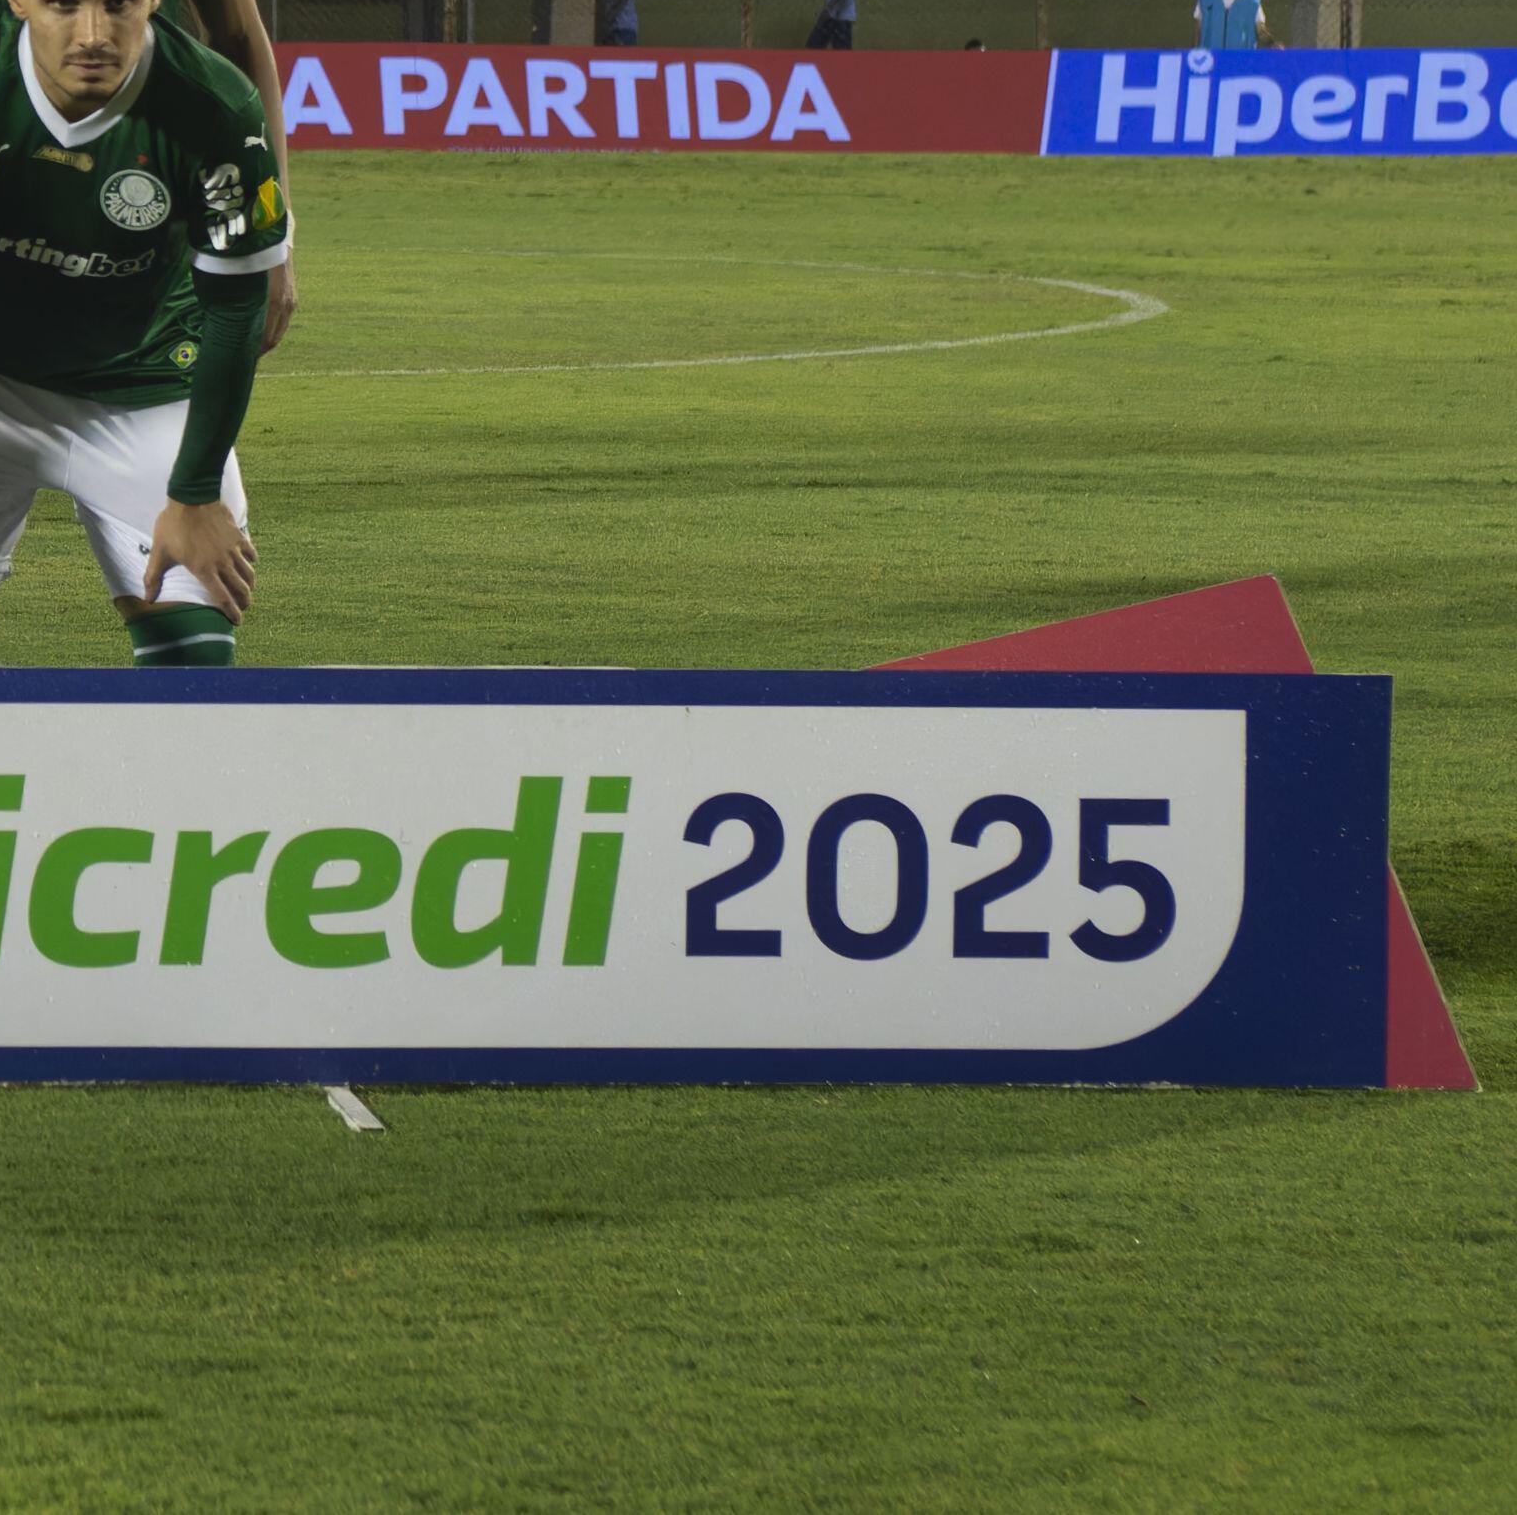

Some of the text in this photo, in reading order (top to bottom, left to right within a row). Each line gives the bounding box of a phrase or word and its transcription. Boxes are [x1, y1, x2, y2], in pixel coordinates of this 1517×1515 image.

[283, 57, 354, 136] A
[378, 56, 852, 142] PARTIDA
[104, 191, 166, 227] PALMEIRAS
[681, 791, 1178, 963] 2025
